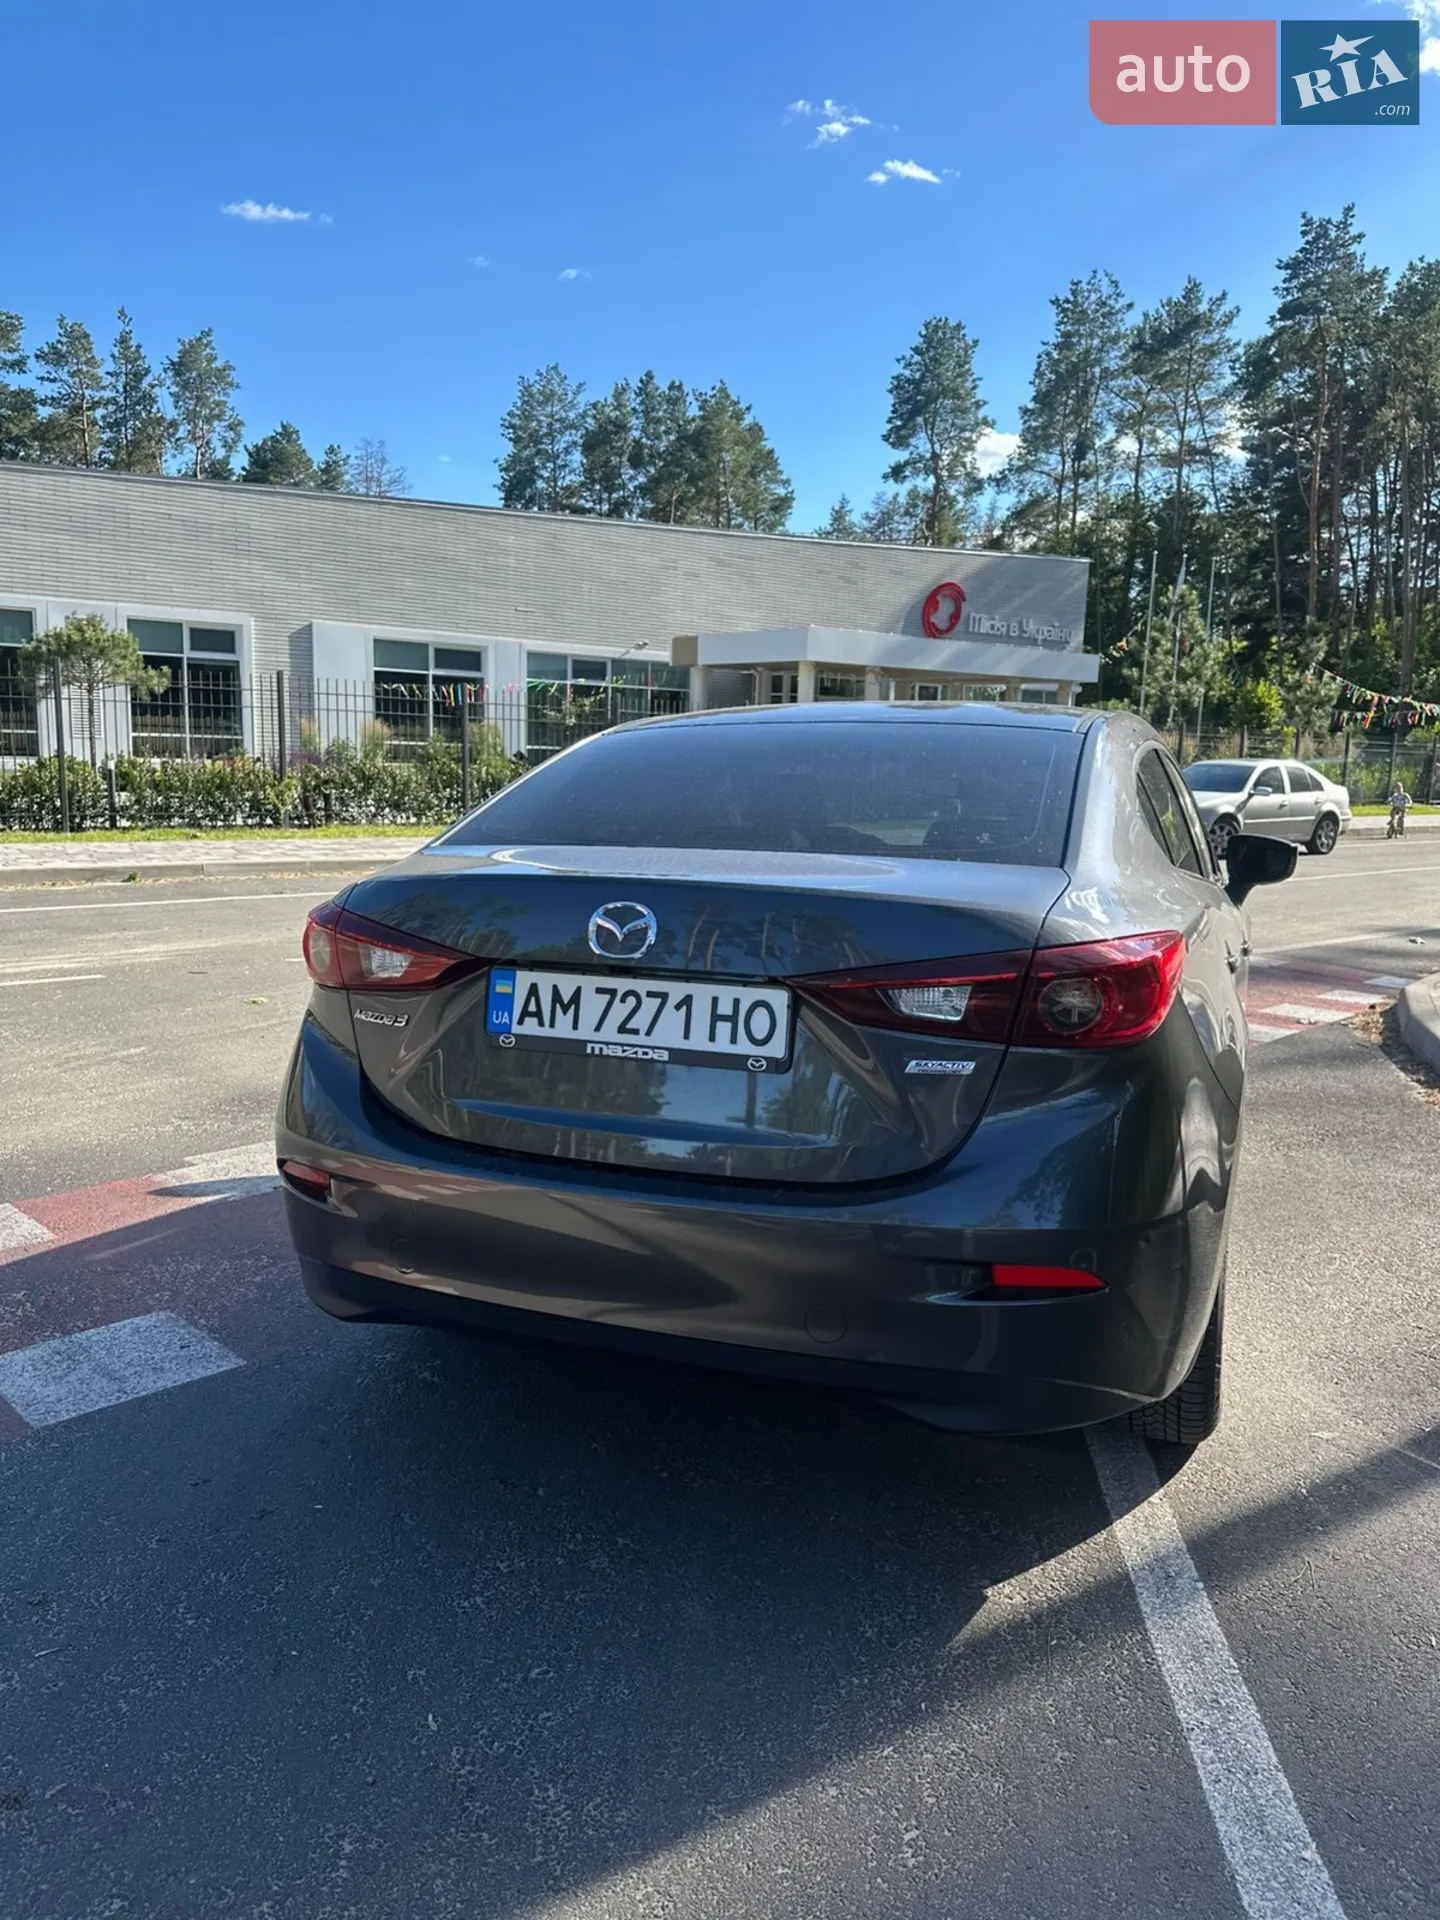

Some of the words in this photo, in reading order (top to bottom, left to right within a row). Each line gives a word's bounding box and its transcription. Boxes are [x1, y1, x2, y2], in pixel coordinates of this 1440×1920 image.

[1010, 622, 1019, 637] в
[492, 1010, 510, 1025] UA
[516, 982, 581, 1030] AM
[594, 987, 693, 1040] 7271
[708, 996, 777, 1047] HO
